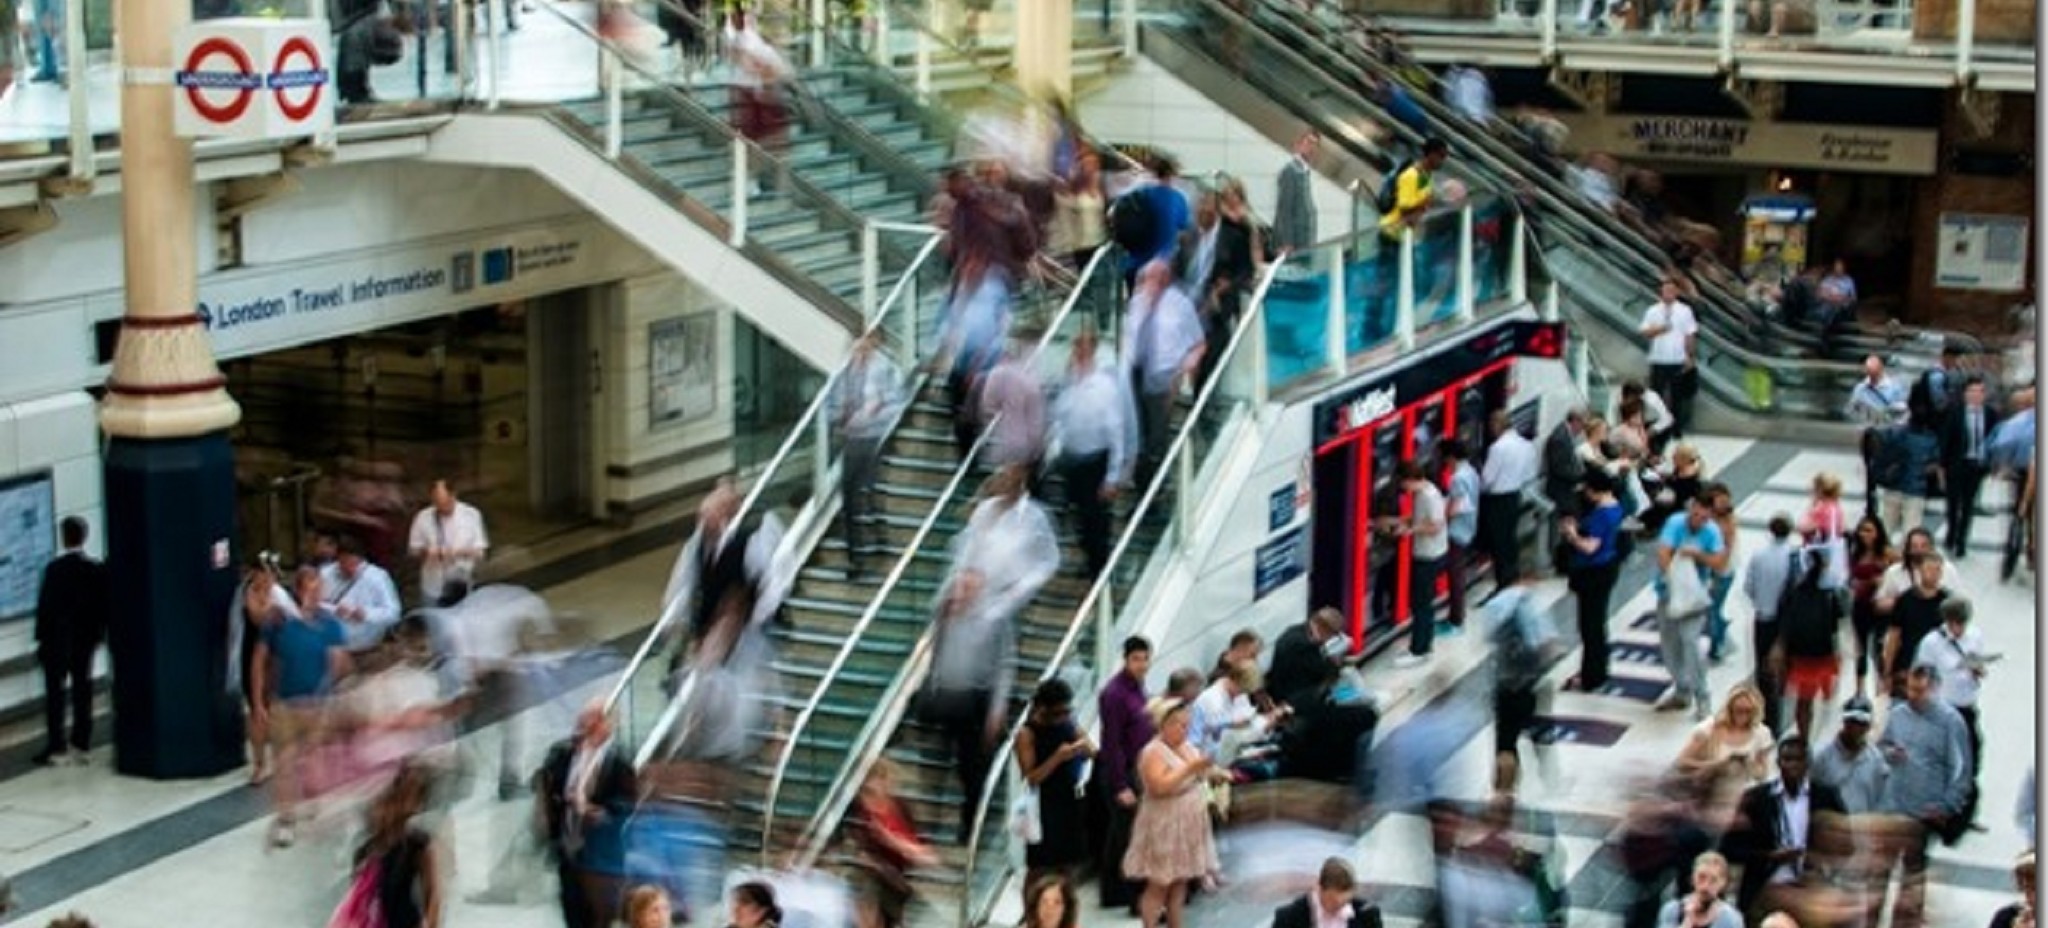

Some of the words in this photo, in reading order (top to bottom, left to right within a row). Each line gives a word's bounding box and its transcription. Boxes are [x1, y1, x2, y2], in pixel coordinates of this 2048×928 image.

[1632, 120, 1749, 145] MERCHANT
[217, 297, 286, 329] London
[292, 283, 343, 311] Travel
[351, 267, 445, 302] Information
